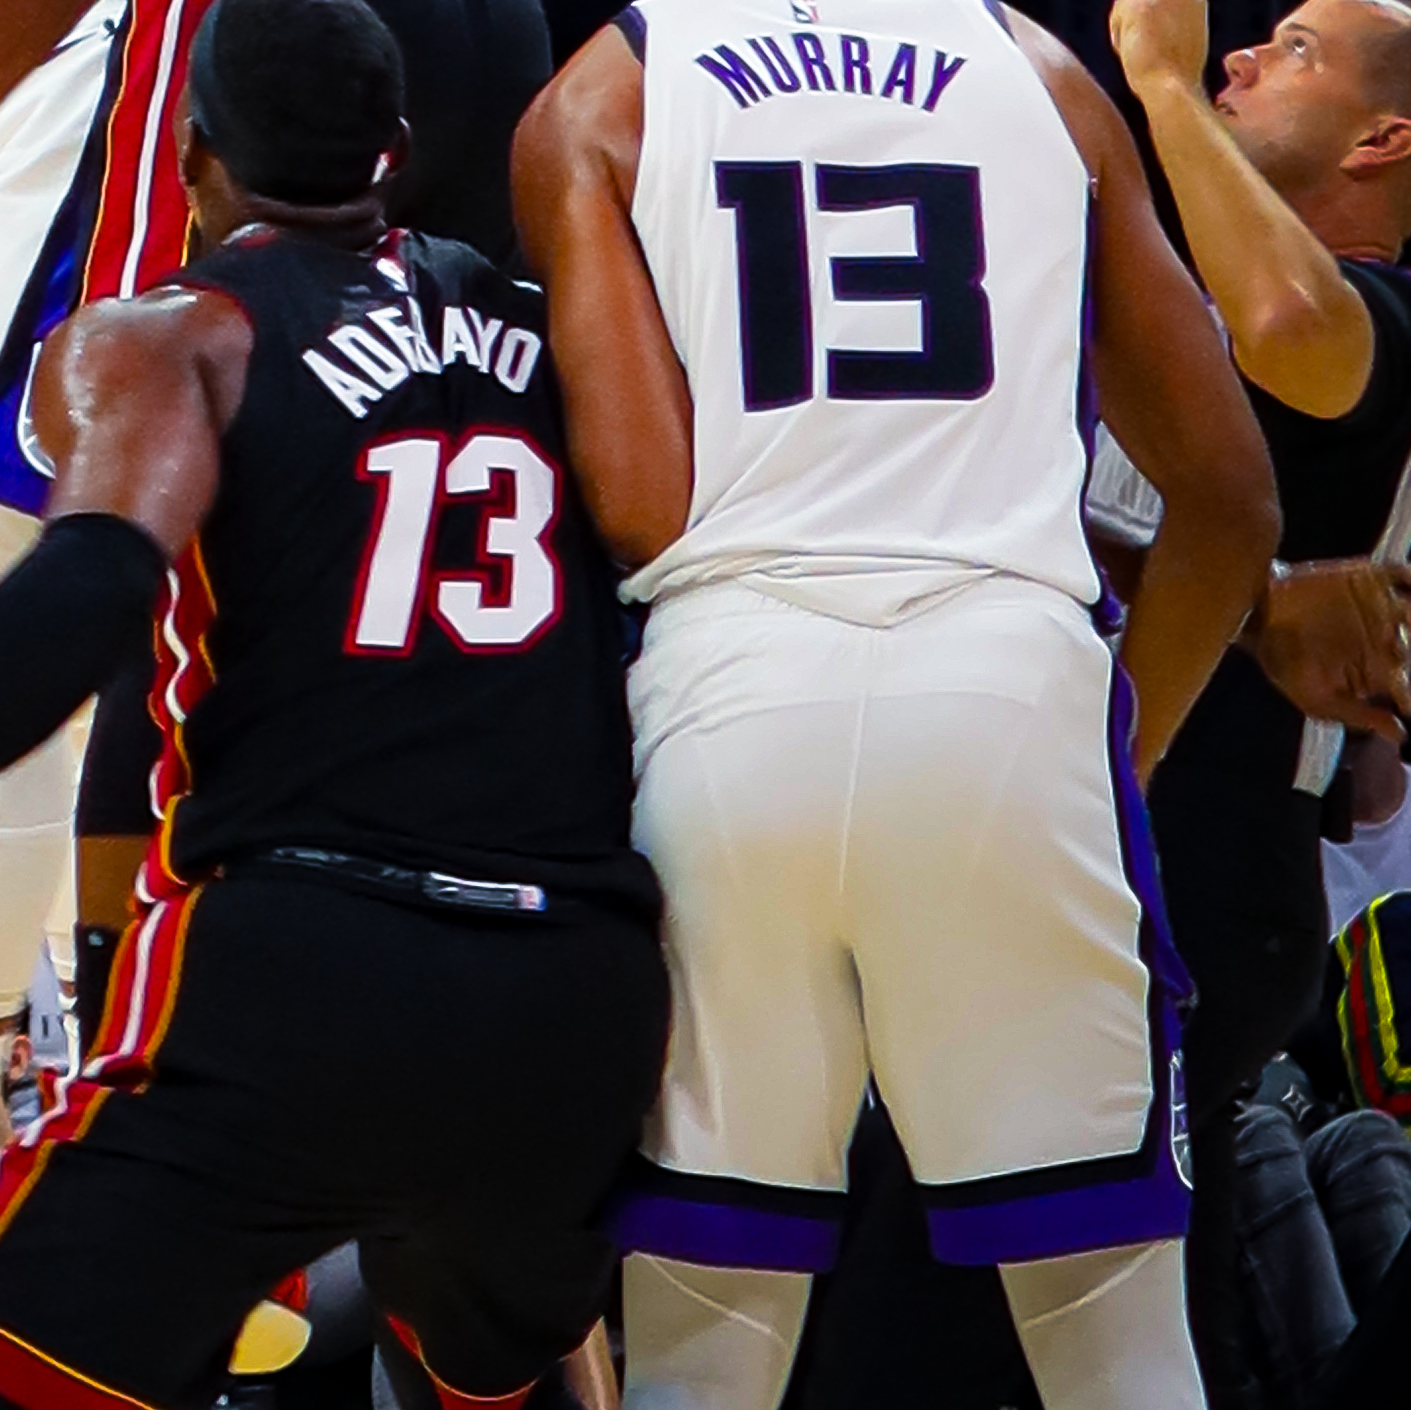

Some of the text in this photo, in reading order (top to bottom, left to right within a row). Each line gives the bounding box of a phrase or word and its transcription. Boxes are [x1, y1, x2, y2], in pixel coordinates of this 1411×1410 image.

[693, 32, 968, 114] MURRAY
[712, 159, 996, 413] 13
[345, 428, 562, 655] 13
